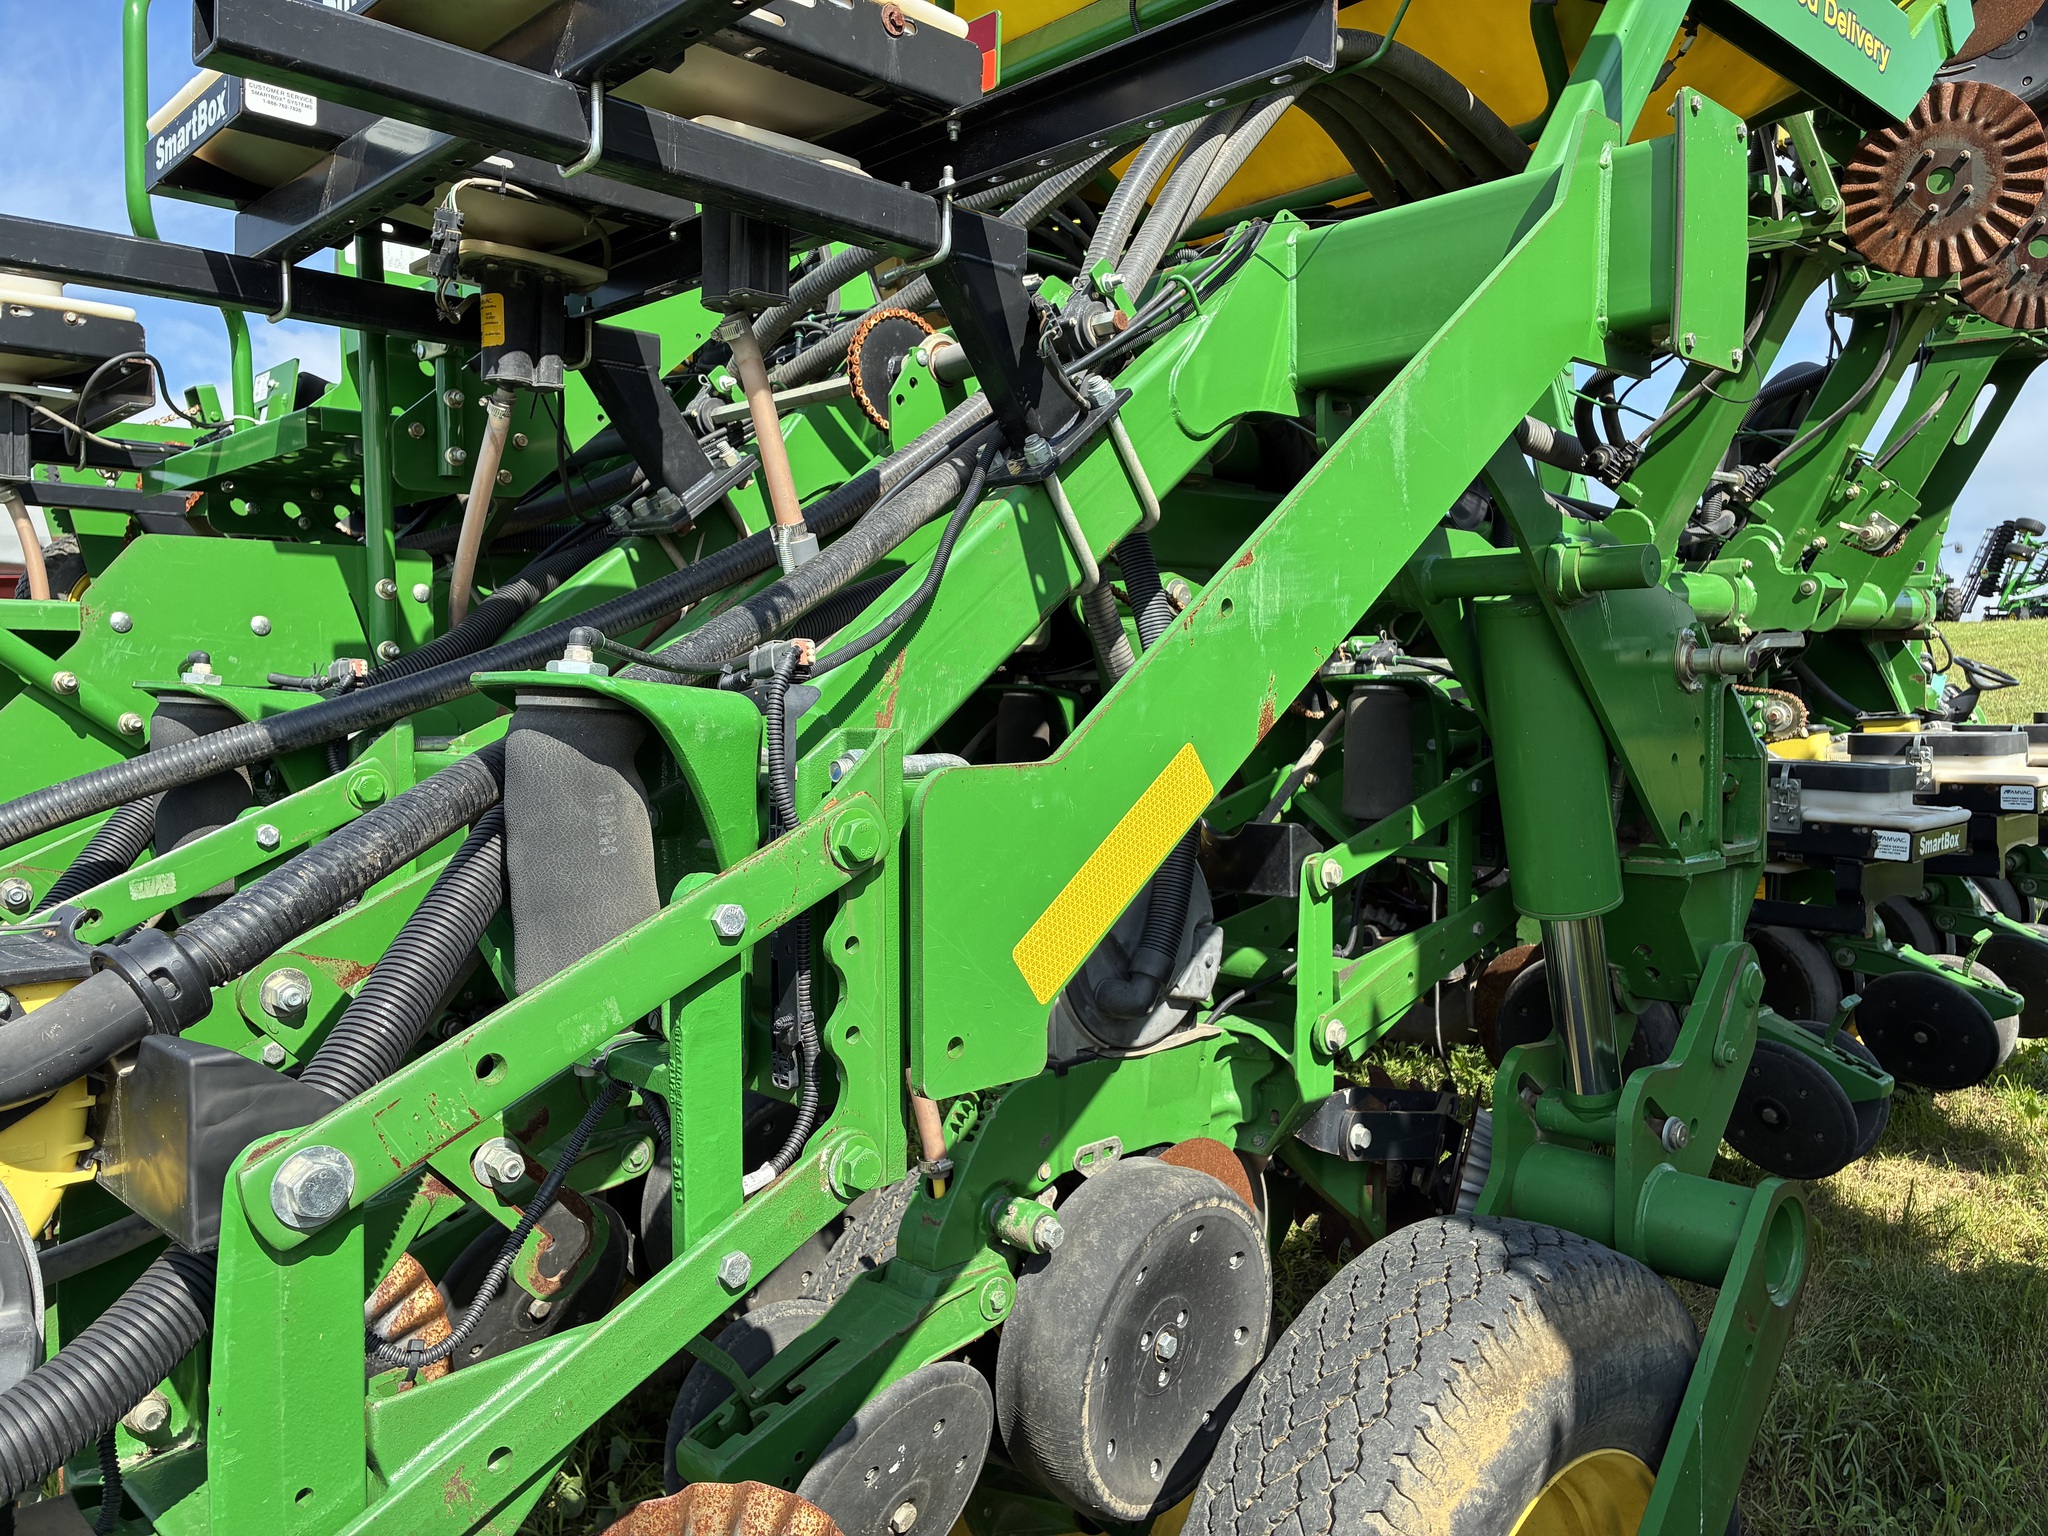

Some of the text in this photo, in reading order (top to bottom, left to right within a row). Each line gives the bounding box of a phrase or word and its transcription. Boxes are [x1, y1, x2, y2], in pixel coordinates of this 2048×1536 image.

[1823, 0, 1892, 74] Delivery
[248, 82, 314, 105] CUSTOMER SERVICE
[287, 99, 313, 110] SYSTEMS
[155, 88, 227, 171] SmartBox
[1920, 831, 1960, 856] SmartBox
